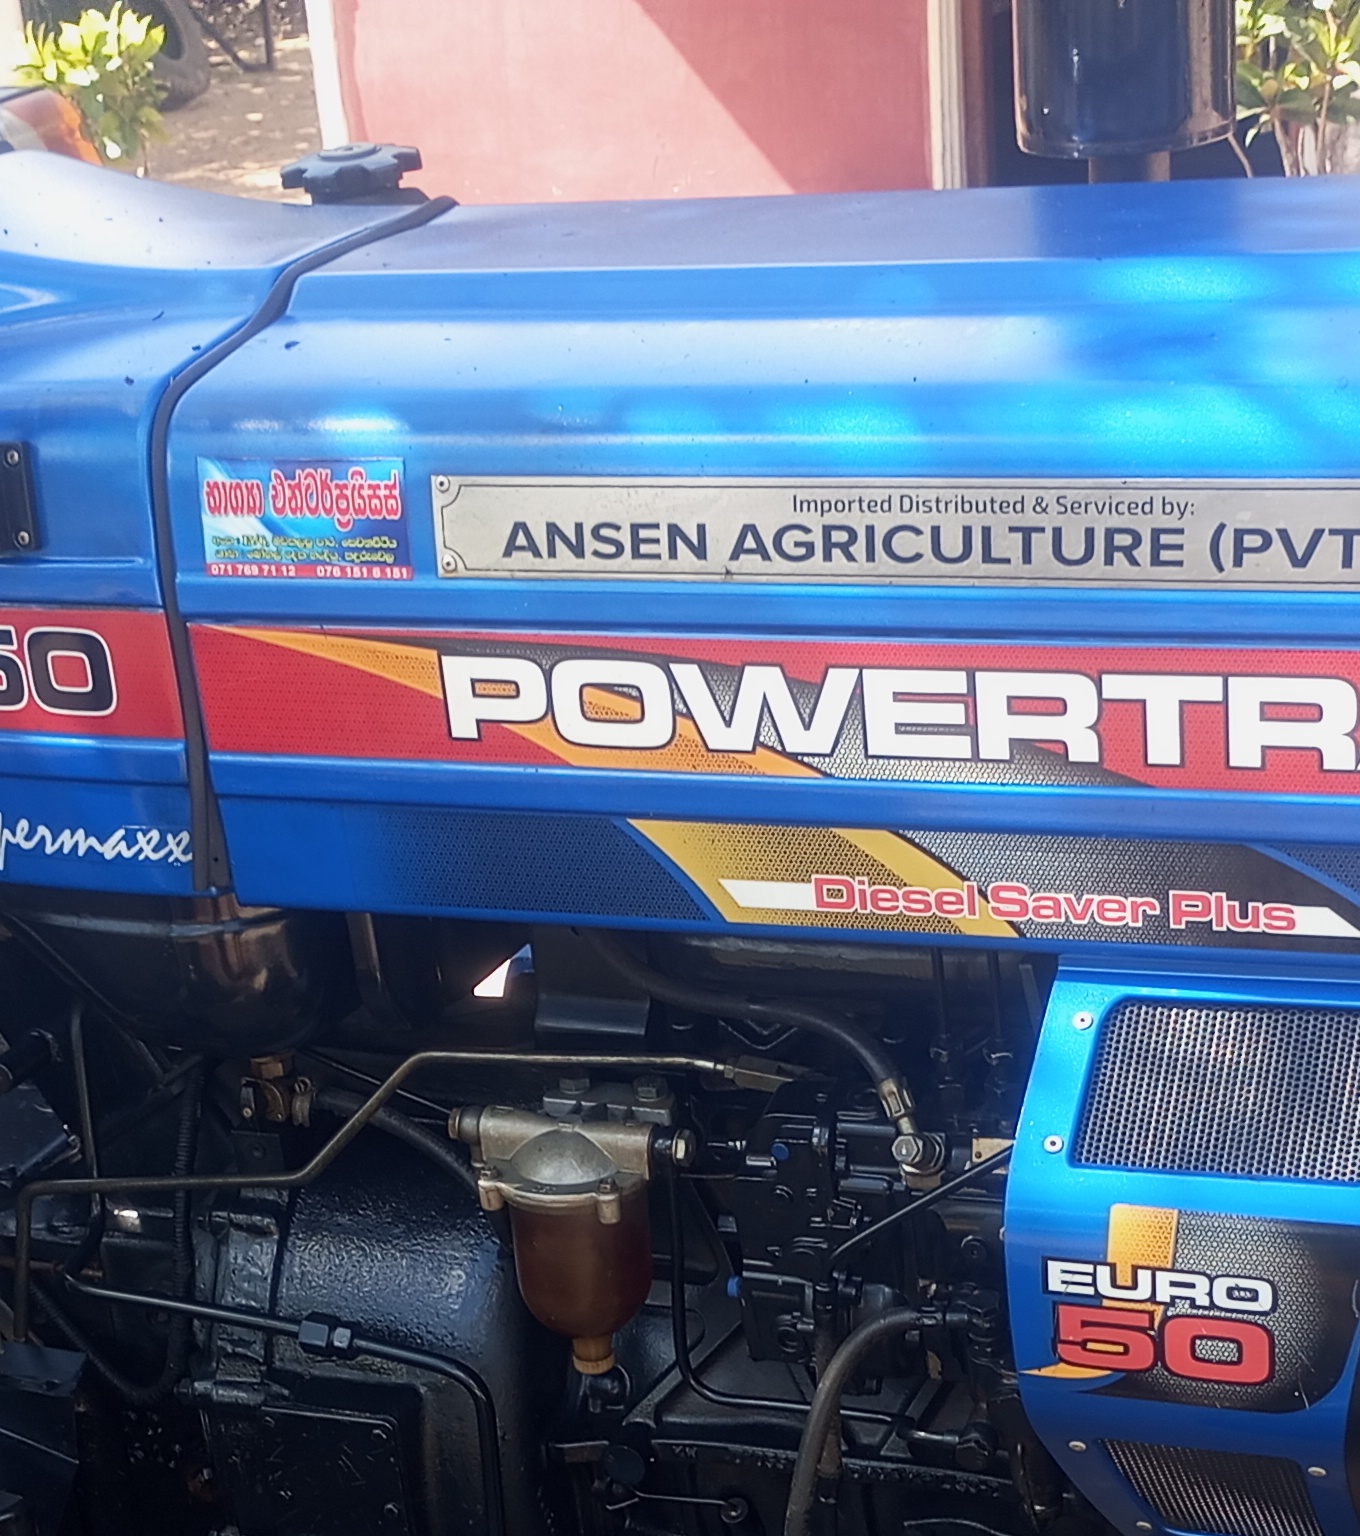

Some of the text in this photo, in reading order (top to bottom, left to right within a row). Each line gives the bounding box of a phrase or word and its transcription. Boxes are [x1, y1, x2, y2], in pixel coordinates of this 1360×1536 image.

[793, 494, 1196, 521] Imported Distributed & Serviced by:
[502, 521, 708, 561] ANSEN
[729, 523, 1185, 567] AGRICULTURE
[811, 874, 1297, 934] Diesel Saver Plus
[1045, 1259, 1274, 1313] EURO
[1056, 1304, 1272, 1384] 50
